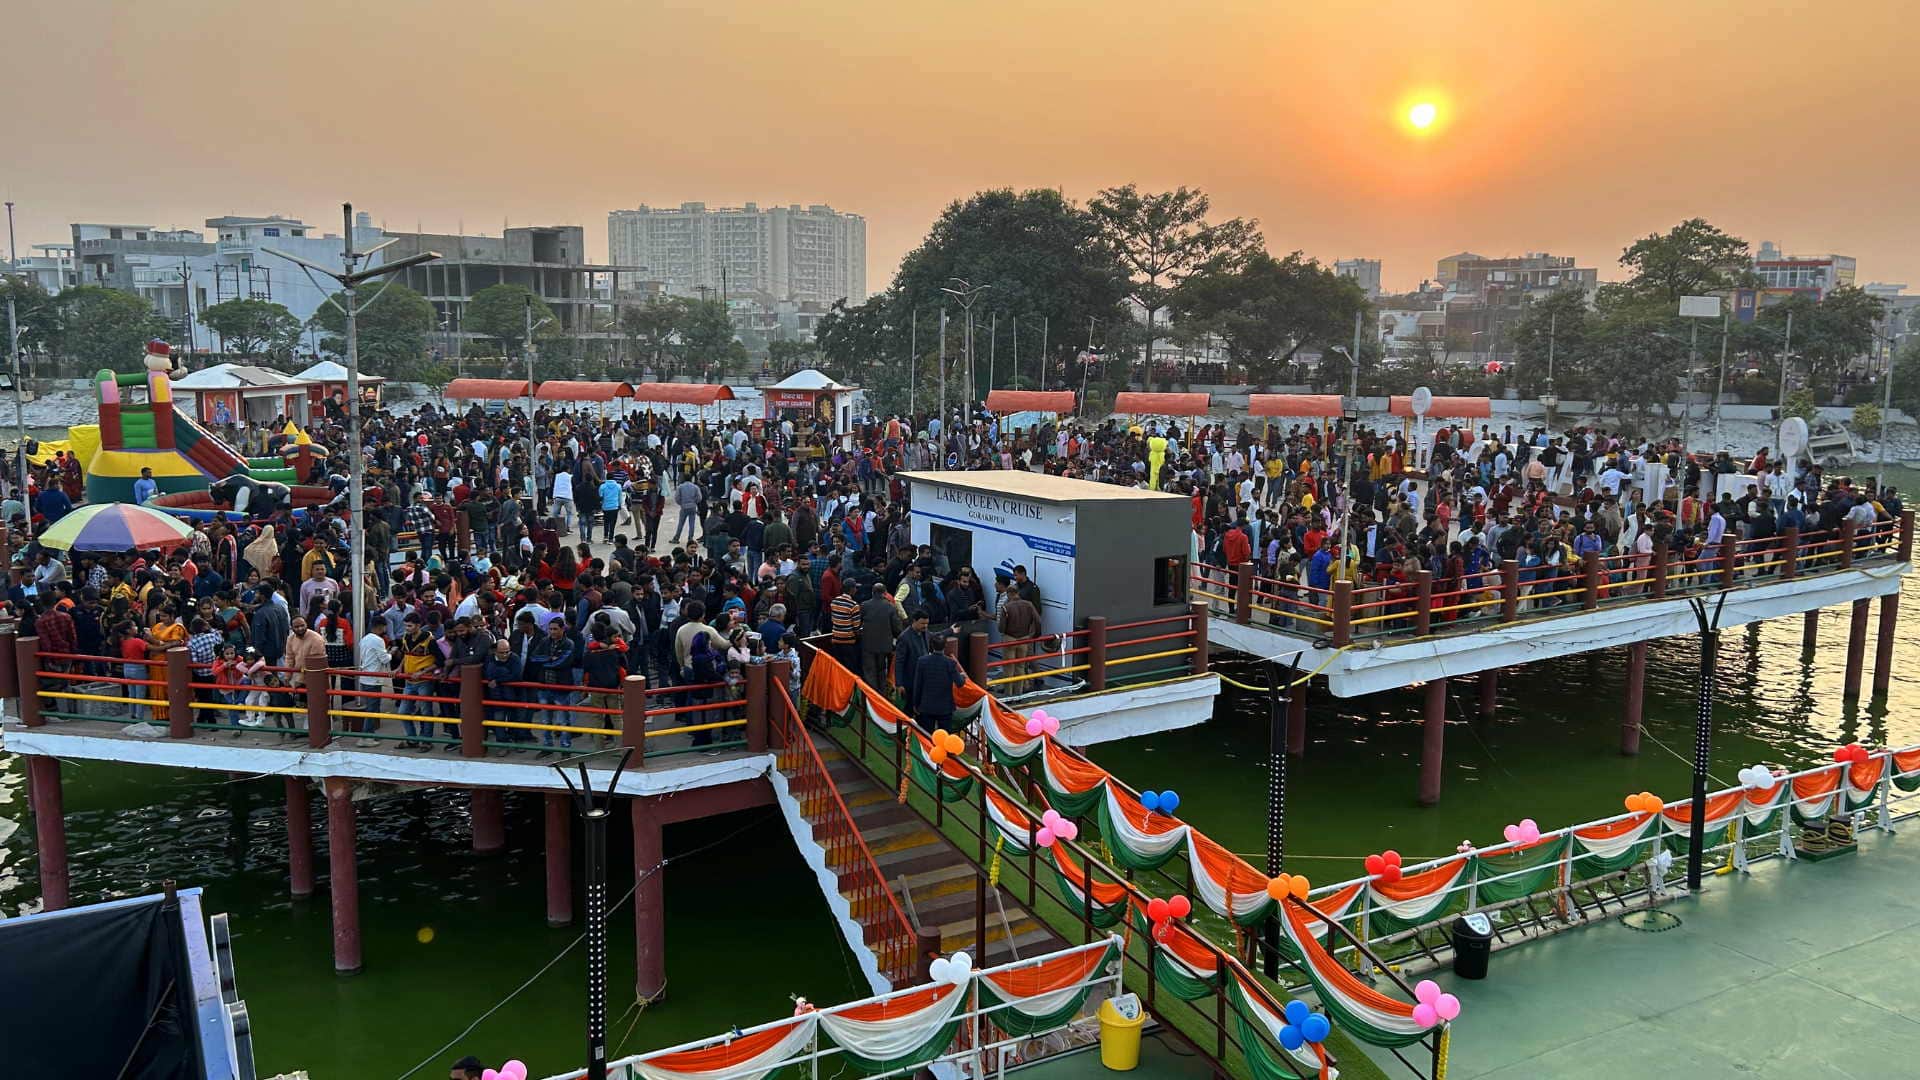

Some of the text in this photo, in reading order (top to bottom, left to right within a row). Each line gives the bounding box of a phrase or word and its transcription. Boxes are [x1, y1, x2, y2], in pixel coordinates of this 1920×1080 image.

[936, 488, 1043, 520] LAKE QUEEN CRUISE
[968, 511, 1005, 525] GORAKHPUR
